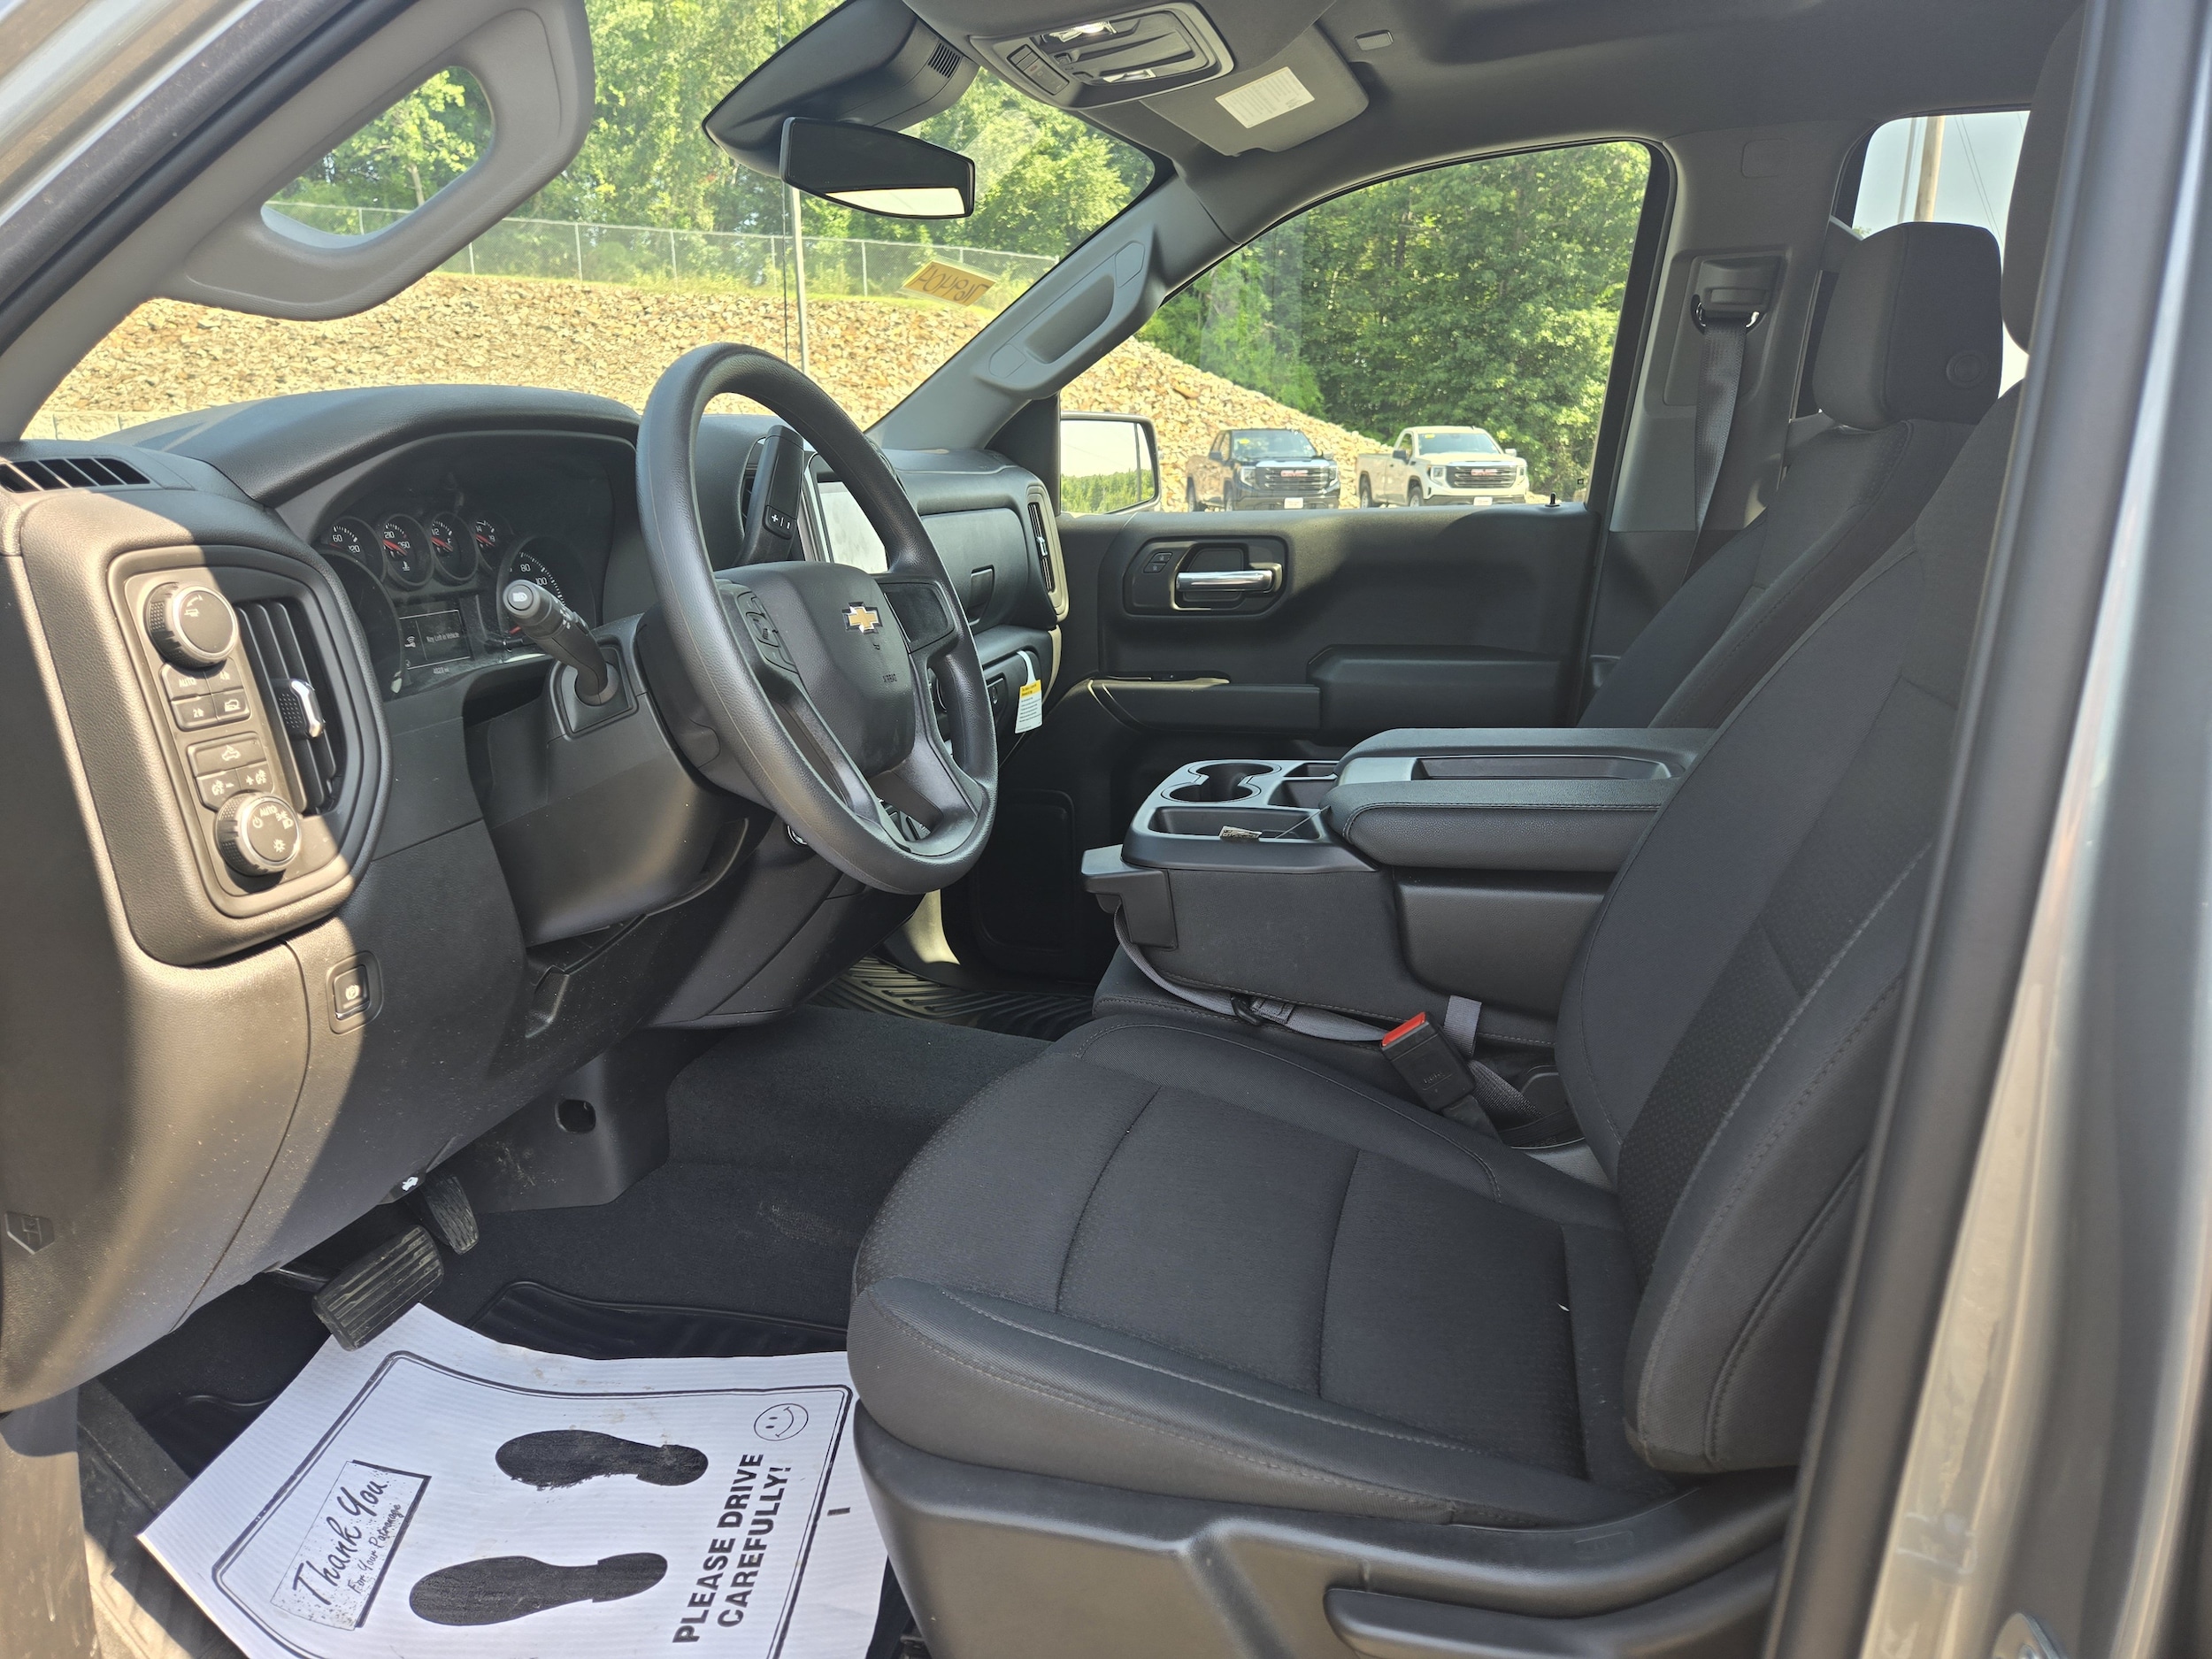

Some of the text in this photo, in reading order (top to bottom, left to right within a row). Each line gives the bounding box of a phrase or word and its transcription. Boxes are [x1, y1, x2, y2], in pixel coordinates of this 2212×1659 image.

[535, 577, 548, 586] 100
[179, 677, 197, 688] AUTO
[259, 804, 278, 818] AUTO
[292, 1516, 362, 1606] Thank
[348, 1503, 405, 1594] For Your Patronage
[672, 1454, 764, 1643] PLEASE DRIVE
[717, 1467, 791, 1627] CAREFULLY!
